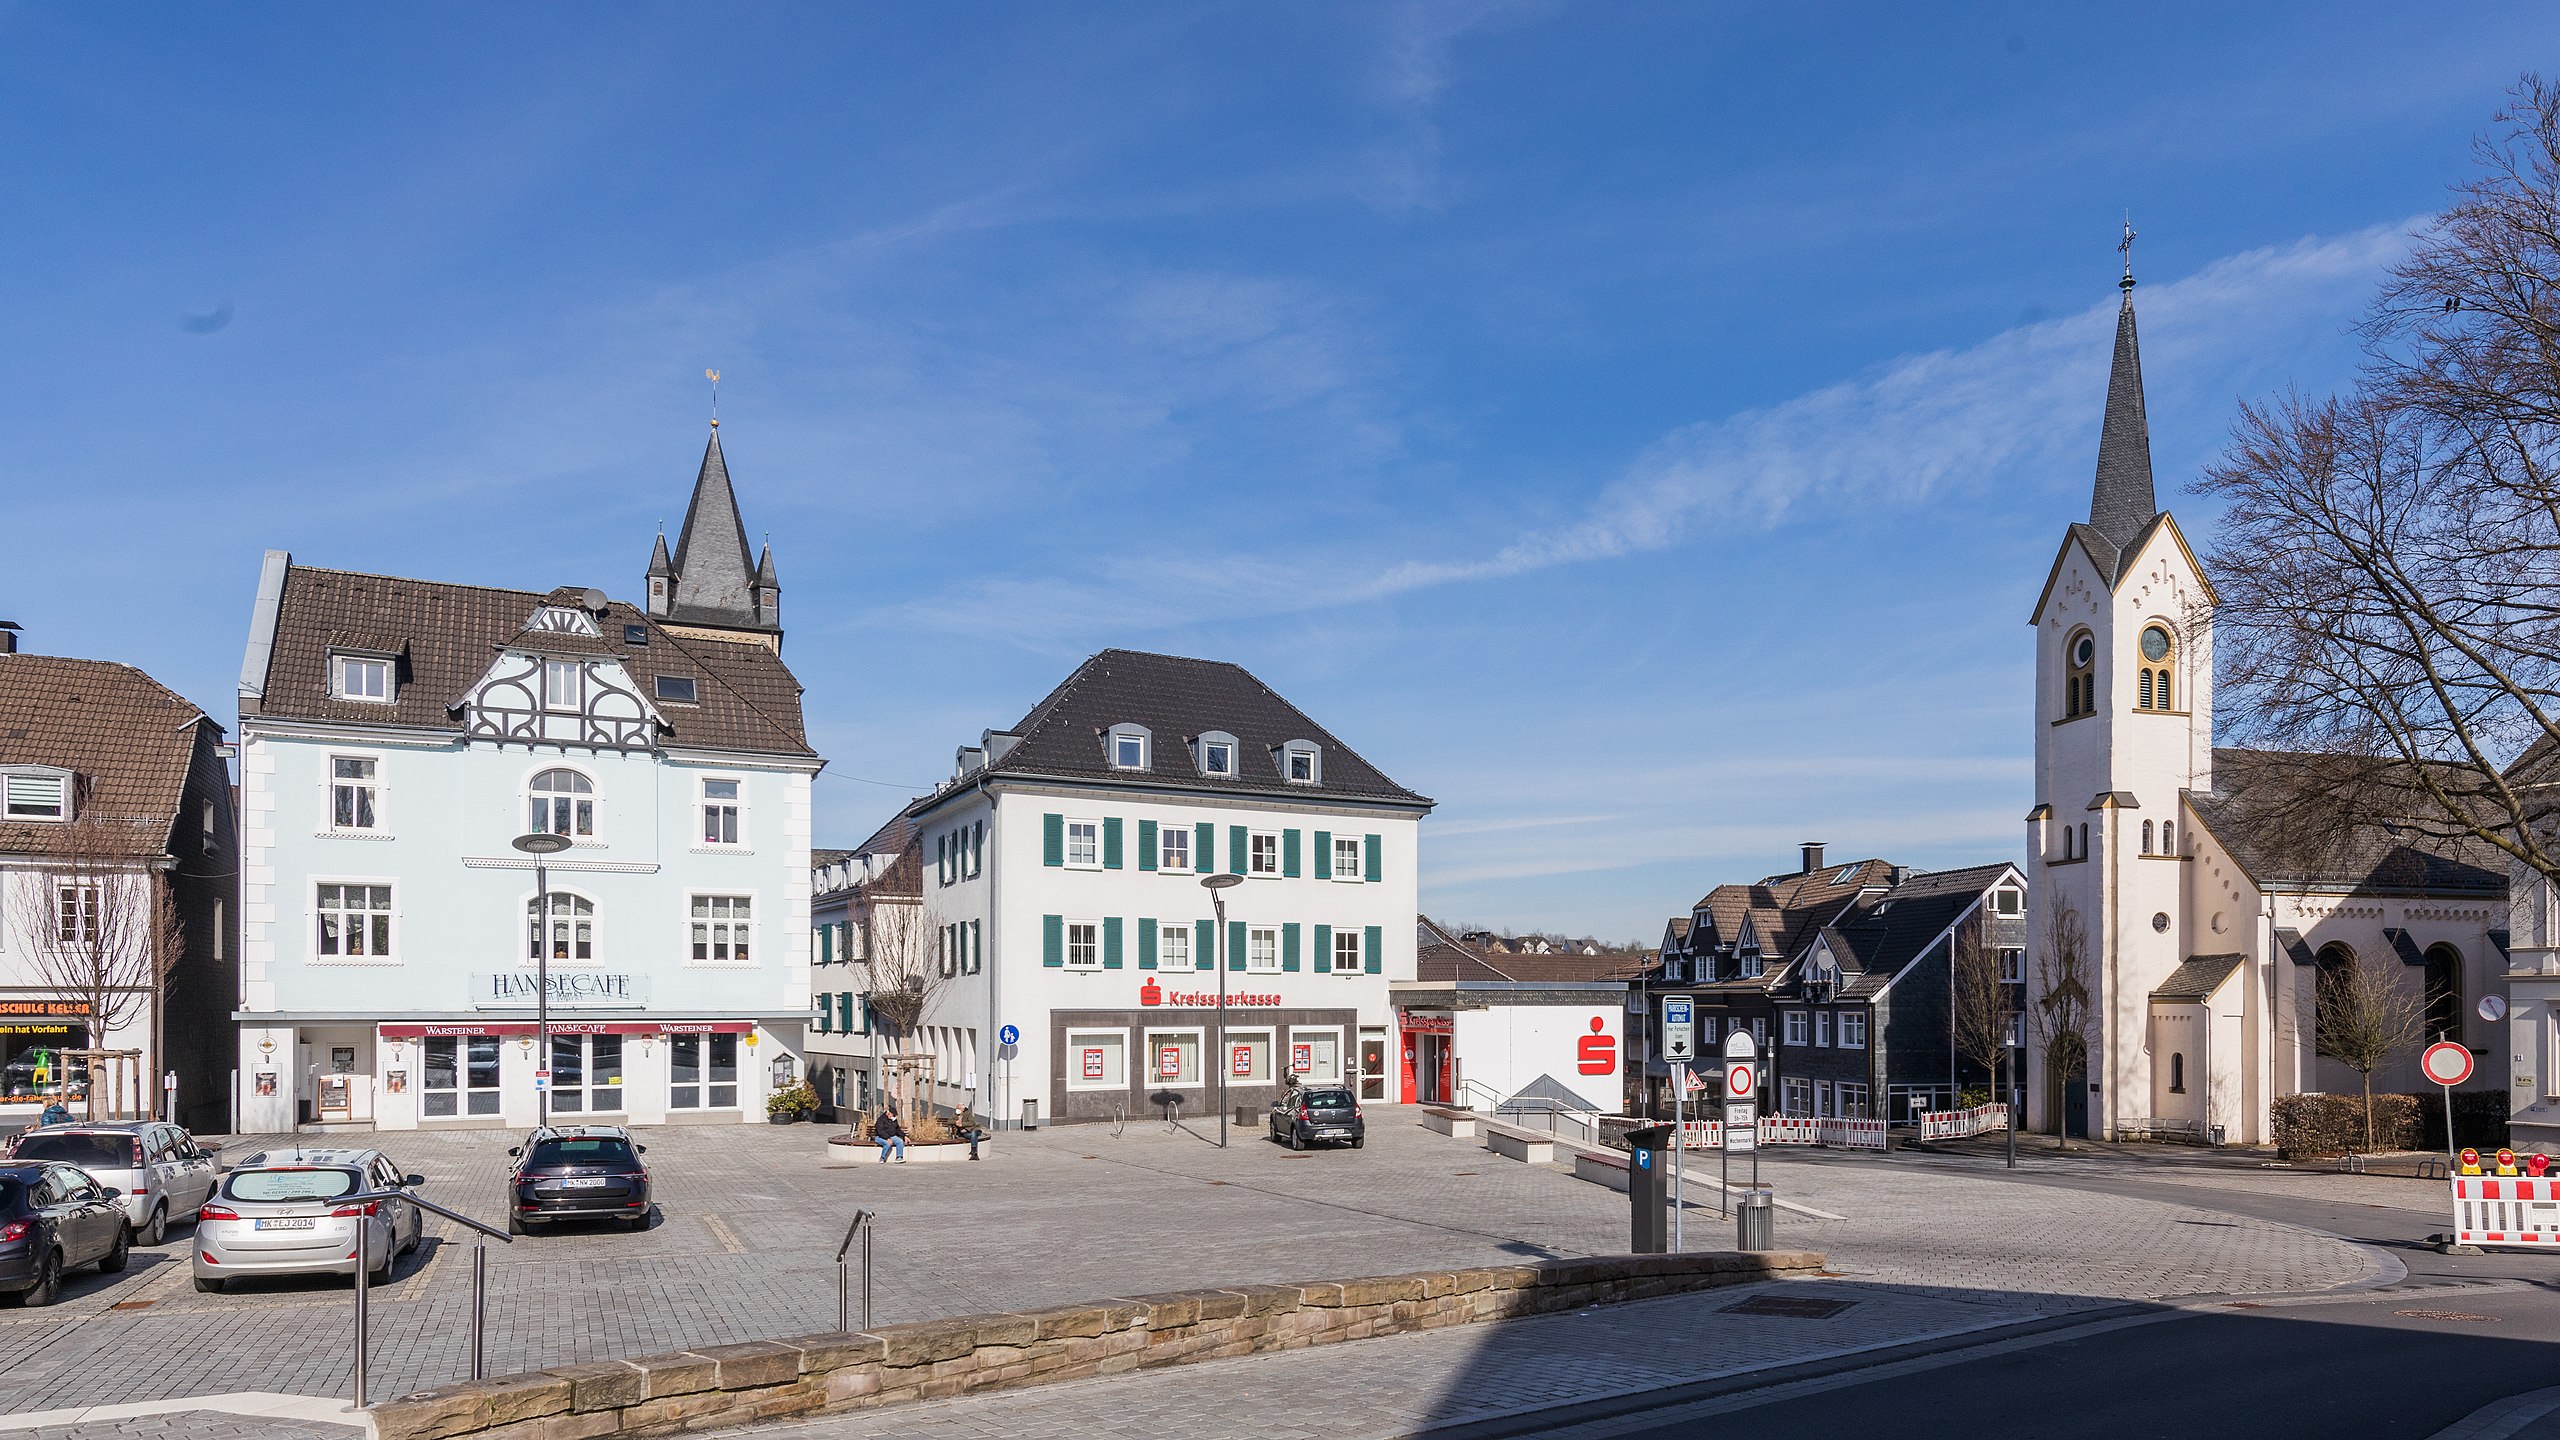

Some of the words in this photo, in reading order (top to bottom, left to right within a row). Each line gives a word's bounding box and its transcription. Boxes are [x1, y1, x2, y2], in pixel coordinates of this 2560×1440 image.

[1169, 990, 1282, 1009] Kreissparkasse
[0, 1003, 45, 1014] SCHULE
[15, 1025, 30, 1034] hat
[32, 1025, 68, 1034] Vorfahrt
[425, 1026, 485, 1035] WARSTEINER
[660, 1024, 714, 1032] WARSTEINER
[1734, 1107, 1748, 1115] Freitag
[1639, 1150, 1649, 1166] P
[291, 1219, 313, 1227] 2014
